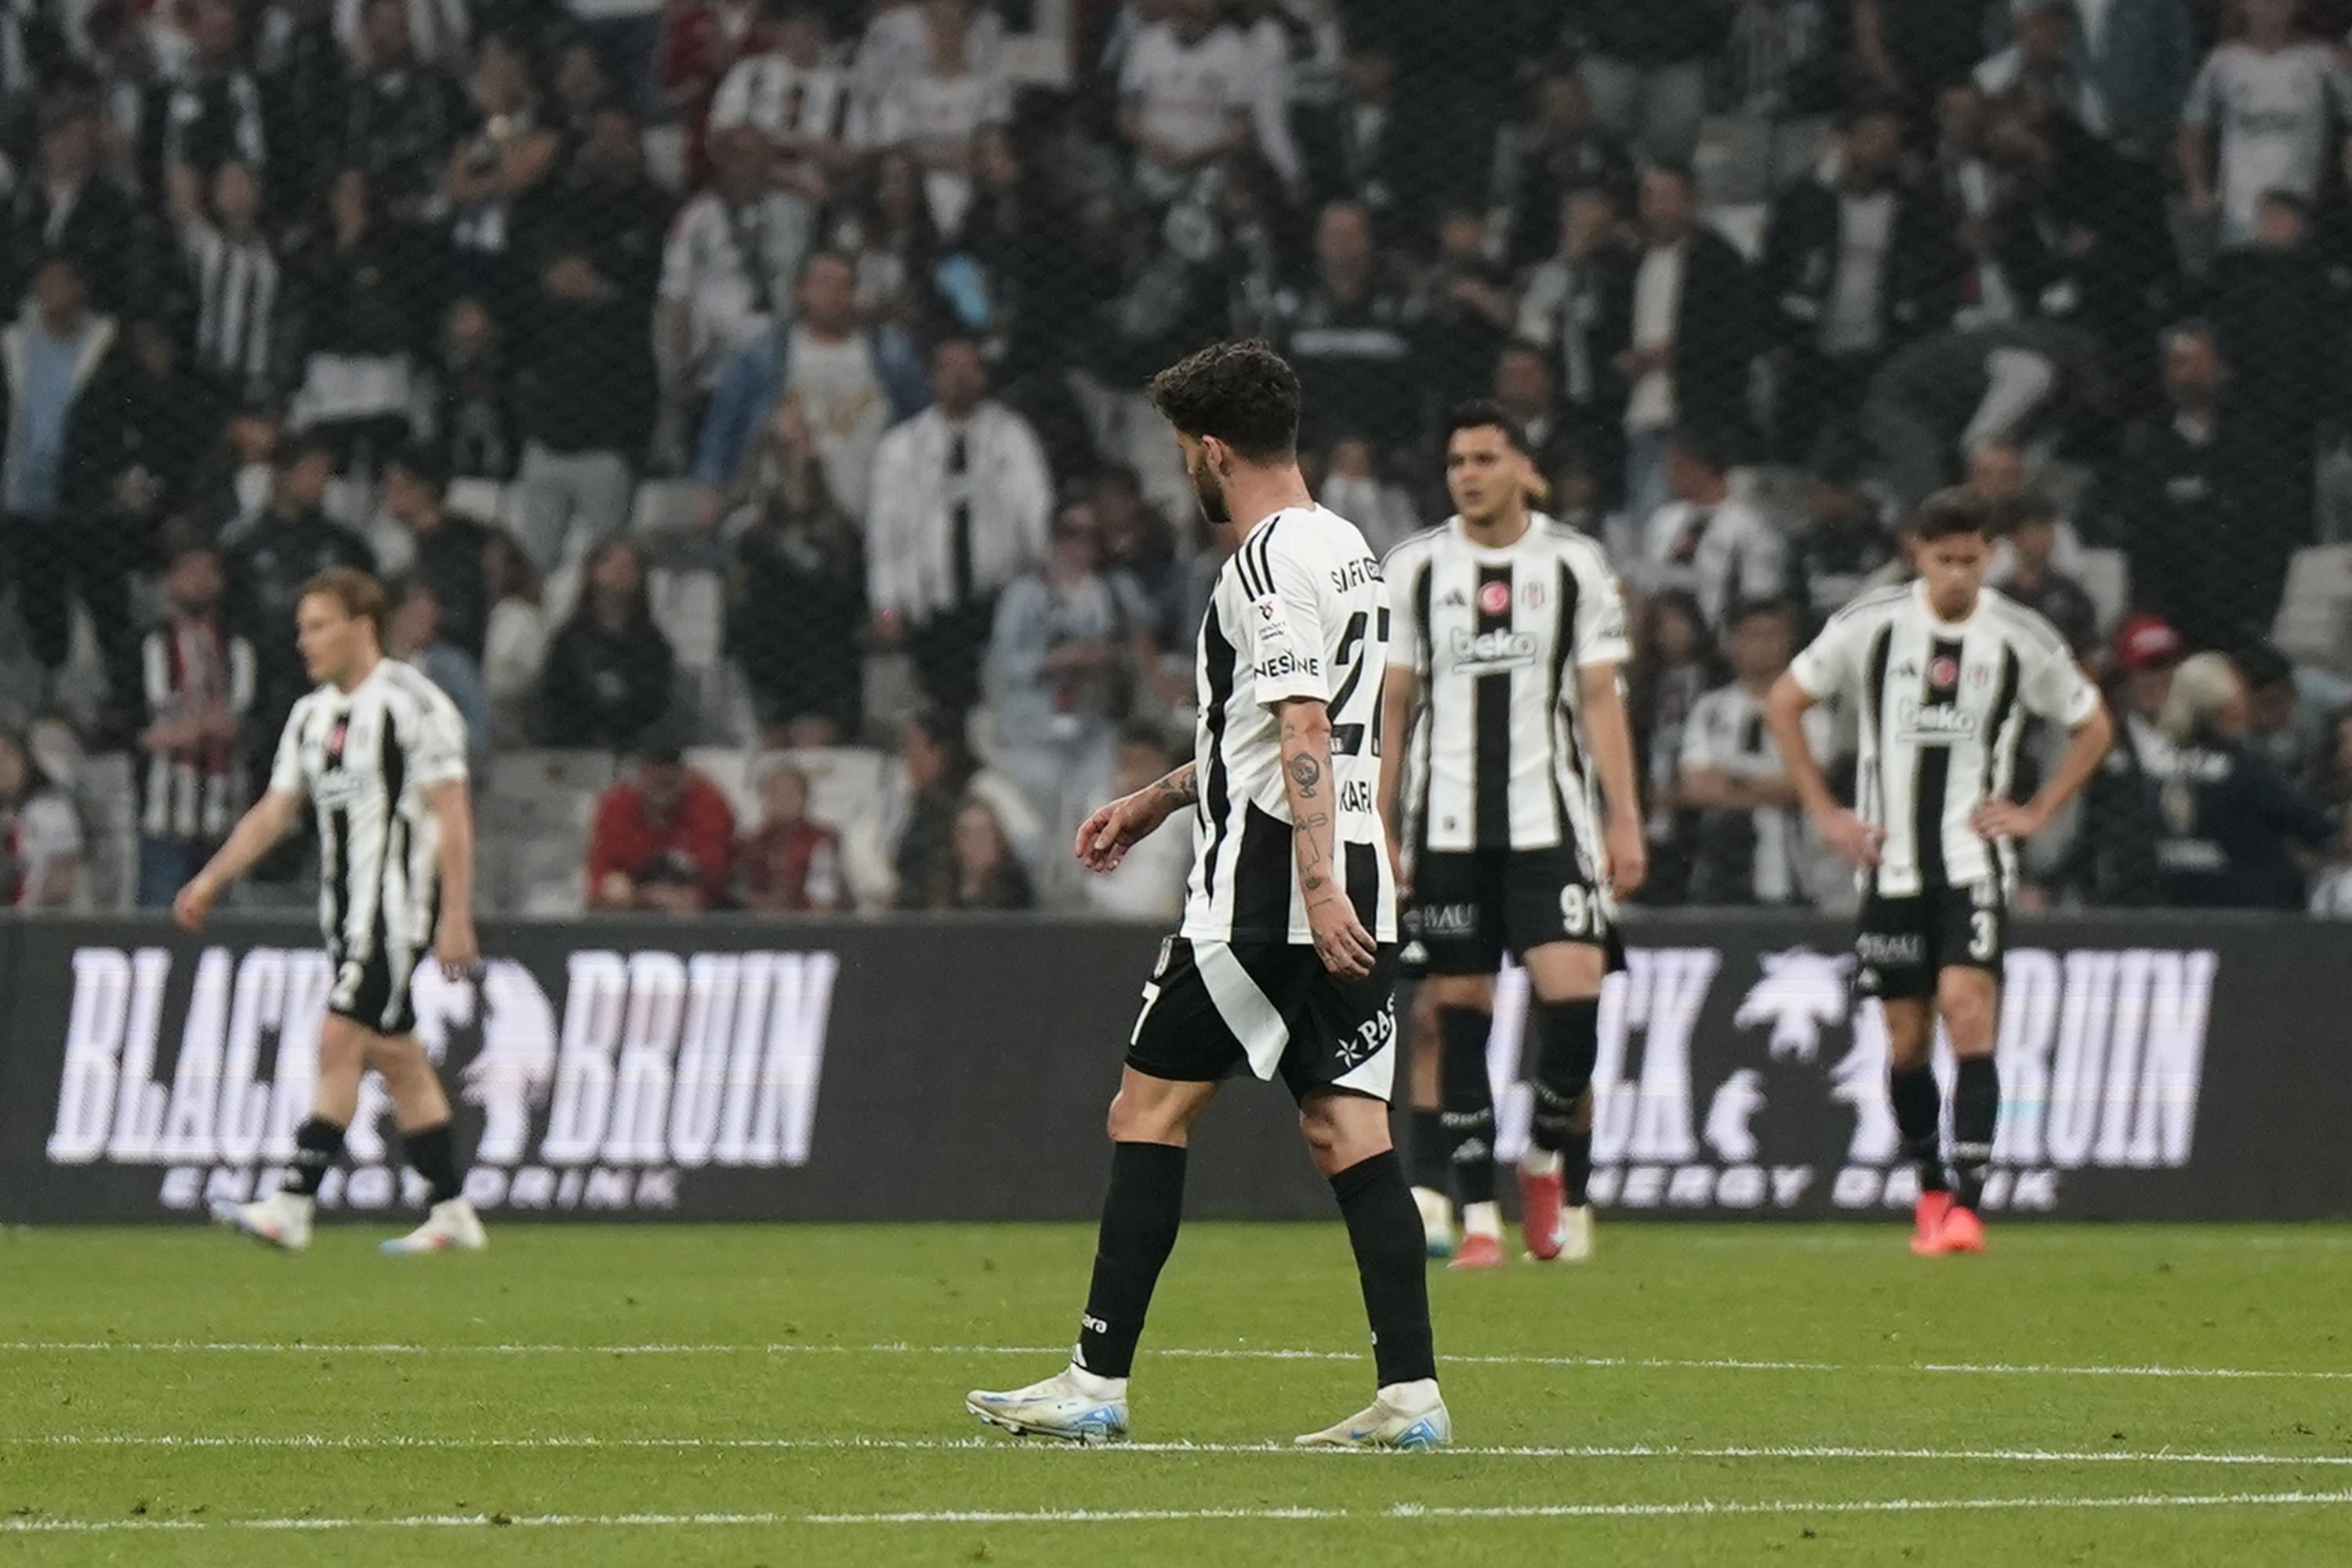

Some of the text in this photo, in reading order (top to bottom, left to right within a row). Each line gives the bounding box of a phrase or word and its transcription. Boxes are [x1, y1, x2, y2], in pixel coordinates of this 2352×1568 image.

[1559, 883, 1606, 937] 91
[1969, 909, 1998, 962] 3
[1130, 980, 1161, 1047] 7
[46, 946, 840, 1168] BLACK BRUIN
[1931, 948, 2219, 1168] RUIN
[466, 1165, 678, 1210] DRINK
[1585, 1164, 2056, 1210] NERGY DRNK
